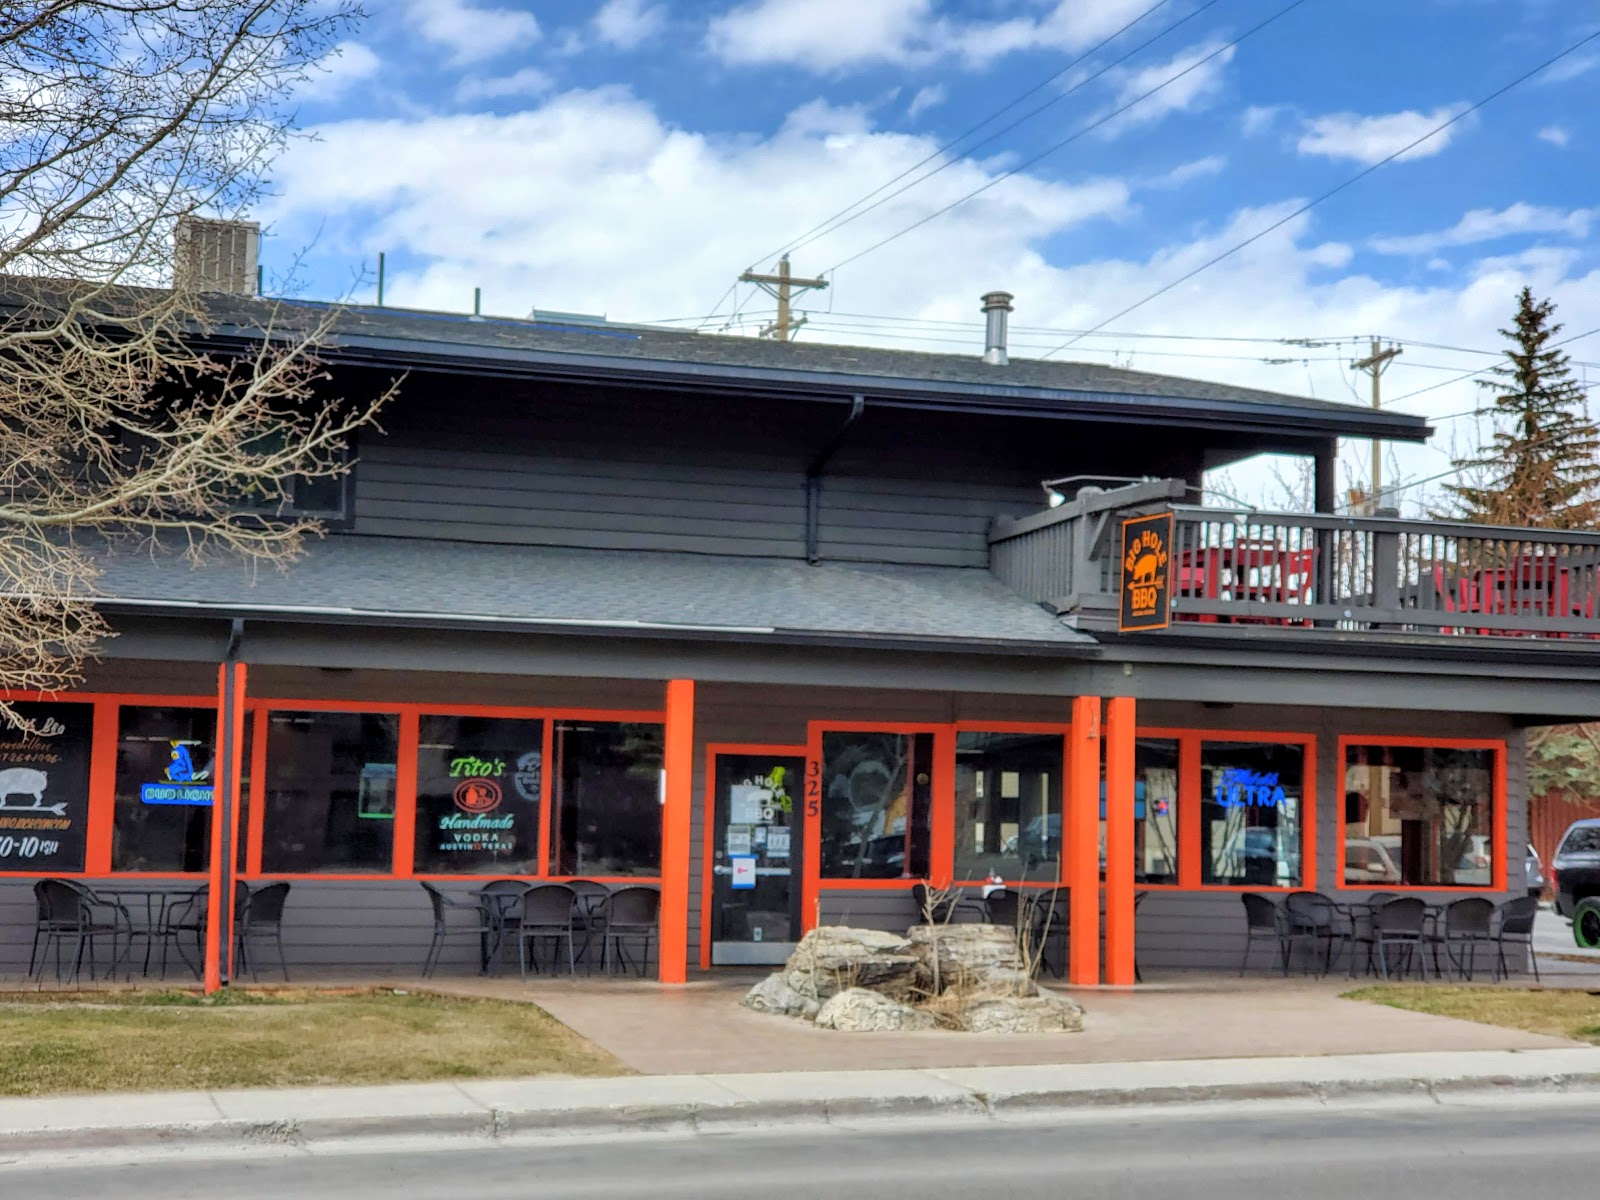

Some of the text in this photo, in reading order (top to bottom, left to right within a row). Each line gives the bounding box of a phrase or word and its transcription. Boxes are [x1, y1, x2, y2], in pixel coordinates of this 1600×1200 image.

[1125, 530, 1168, 572] BIG HOLE
[1131, 586, 1157, 609] BBQ
[449, 756, 505, 777] Tito's
[145, 787, 176, 801] BUD
[755, 775, 785, 797] HOLE
[1217, 786, 1287, 807] ULTRA
[439, 813, 514, 829] Handmade
[0, 835, 40, 858] 0-10
[454, 834, 498, 842] VODKA
